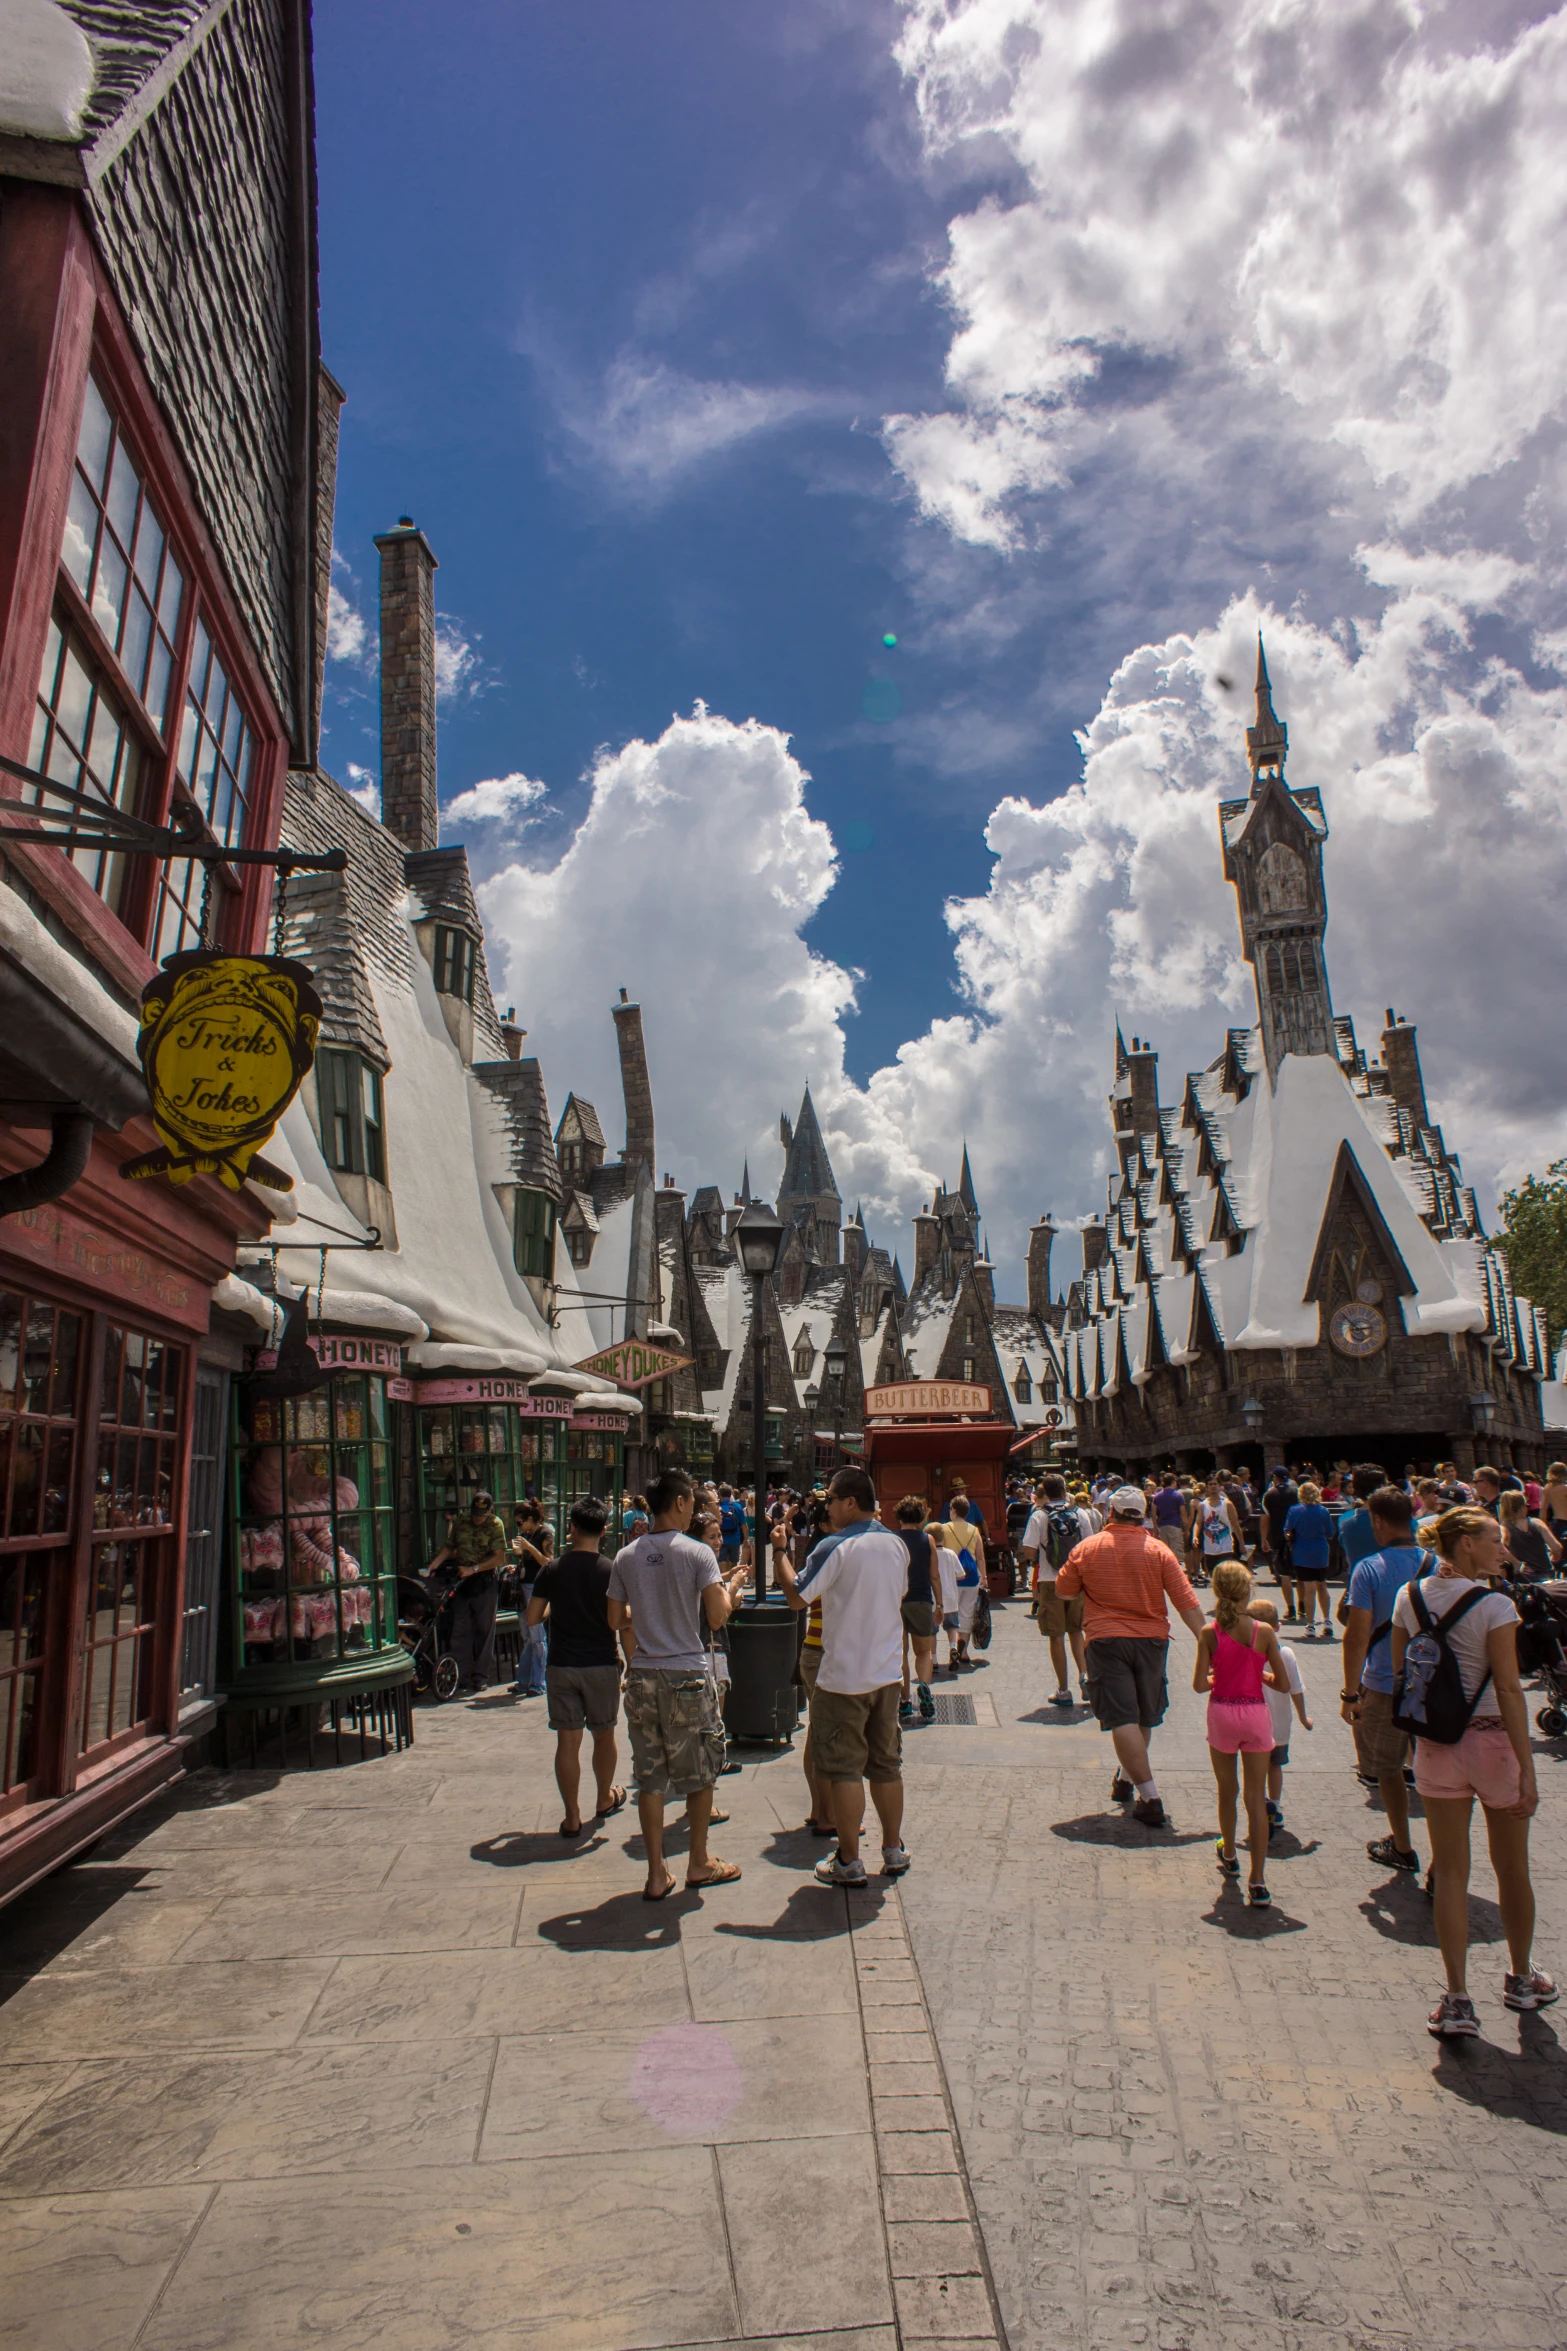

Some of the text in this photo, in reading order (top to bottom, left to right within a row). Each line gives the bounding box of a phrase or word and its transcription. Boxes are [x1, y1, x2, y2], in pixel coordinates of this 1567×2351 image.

[177, 1015, 277, 1055] Tricks
[217, 1056, 235, 1072] &
[173, 1077, 260, 1115] Jokes
[586, 1346, 678, 1382] HONEYDUKES
[873, 1387, 983, 1409] BUTTERBEER
